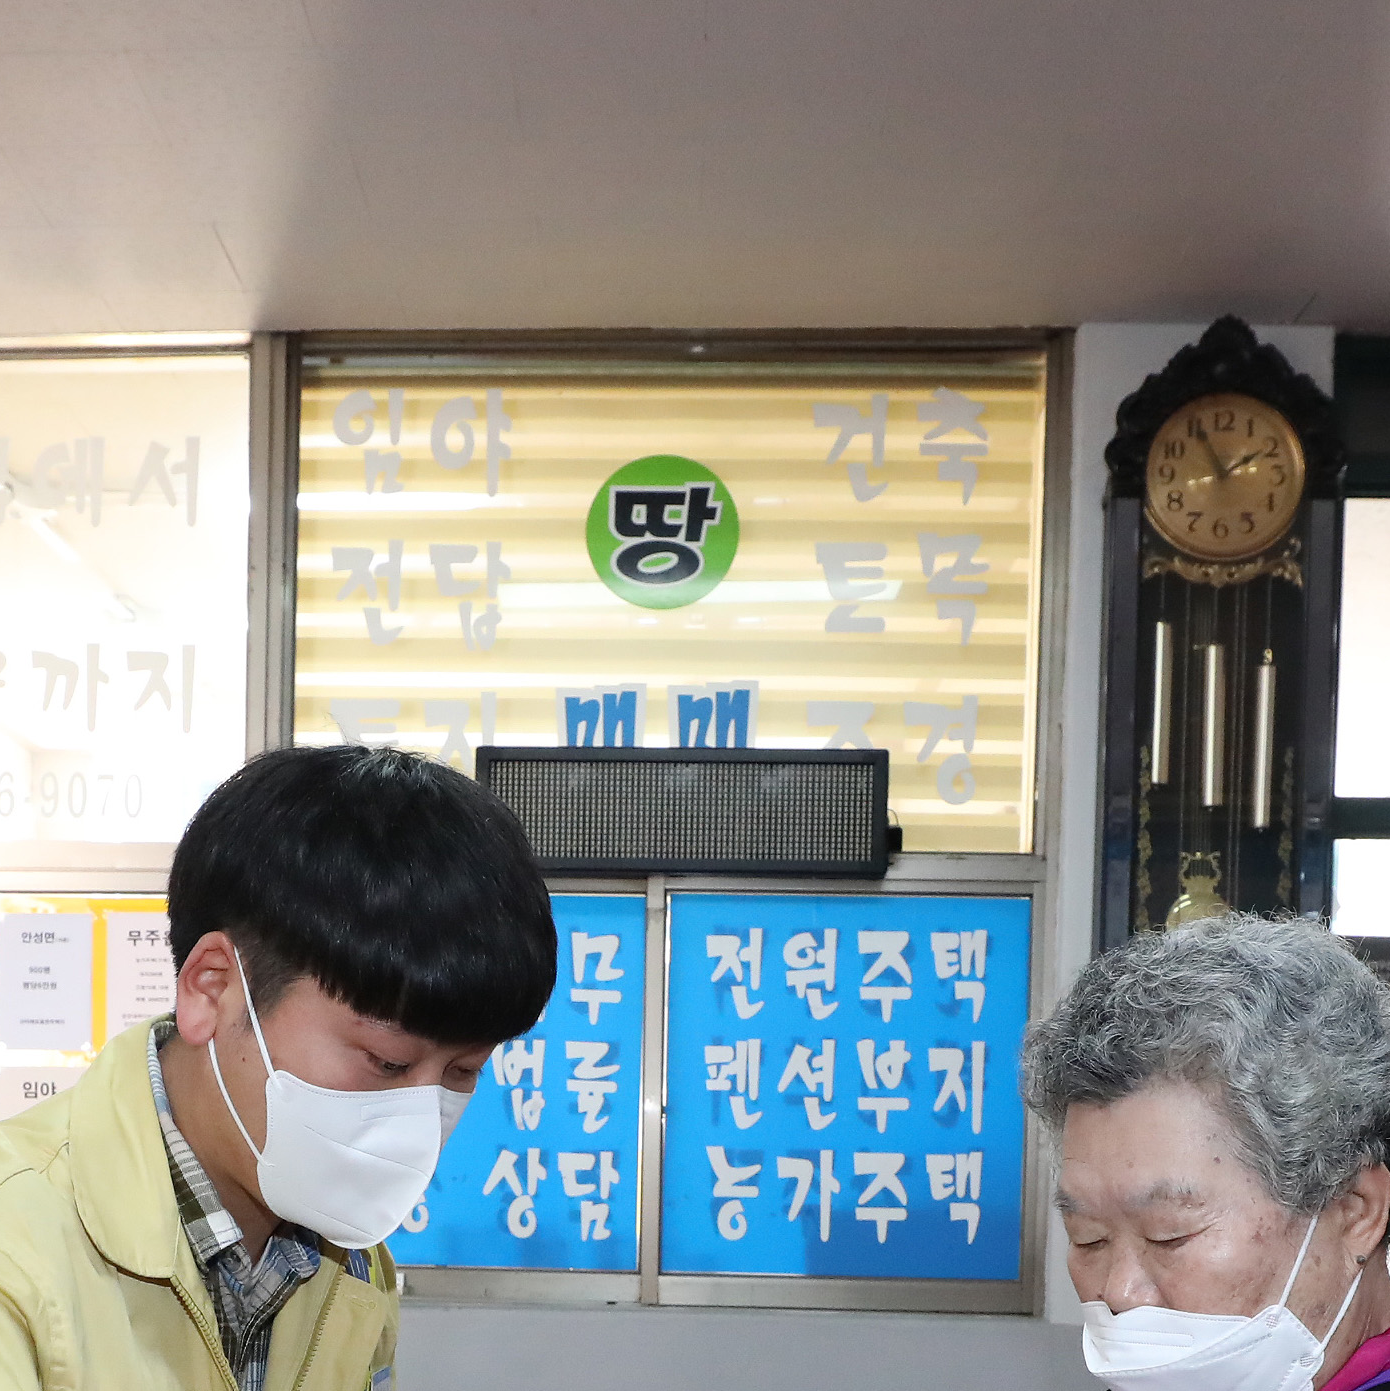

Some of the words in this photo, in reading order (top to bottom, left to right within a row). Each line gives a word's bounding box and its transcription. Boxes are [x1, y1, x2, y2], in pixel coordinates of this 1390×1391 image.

[331, 388, 511, 496] 임야
[813, 386, 989, 504] 건축
[610, 481, 720, 587] 땅
[331, 539, 509, 650] 전답
[816, 532, 988, 646] 토목
[21, 932, 55, 944] 안성면
[706, 928, 988, 1024] 전원주택
[23, 1082, 56, 1098] 임야
[490, 1039, 620, 1134] 법률
[705, 1038, 985, 1134] 펜션부지
[482, 1147, 620, 1242] 상담
[706, 1145, 982, 1245] 농가주택
